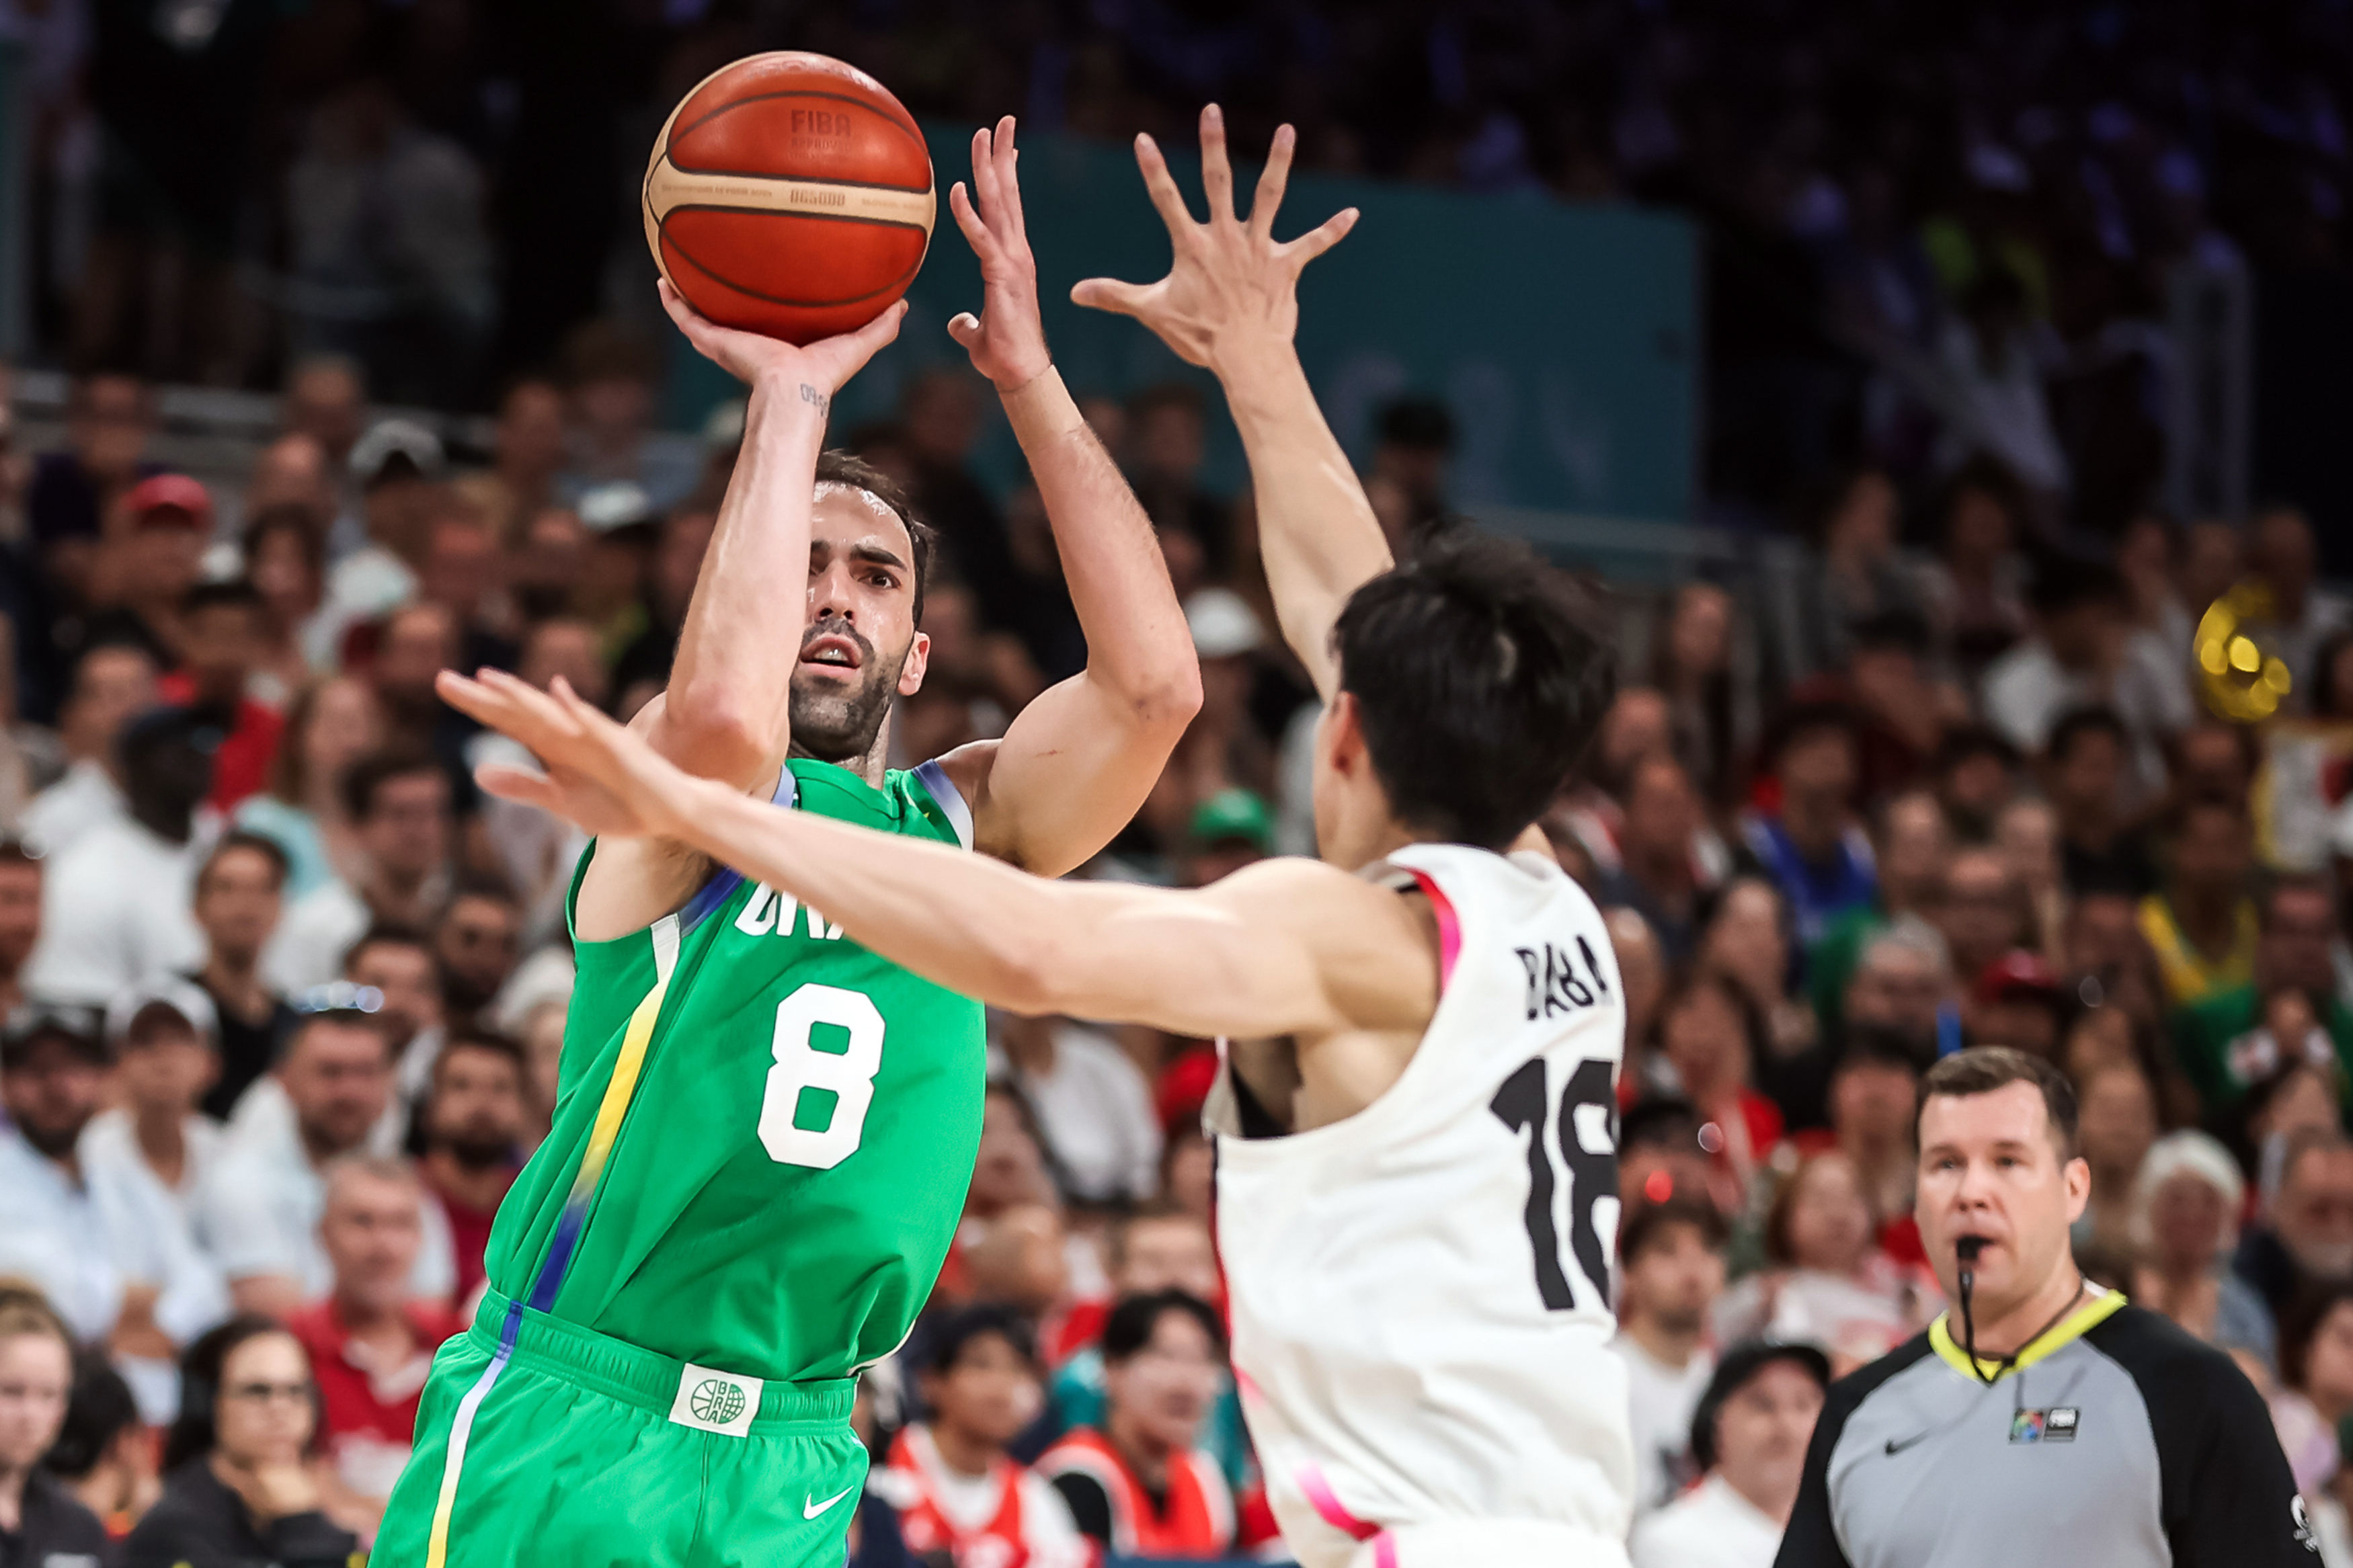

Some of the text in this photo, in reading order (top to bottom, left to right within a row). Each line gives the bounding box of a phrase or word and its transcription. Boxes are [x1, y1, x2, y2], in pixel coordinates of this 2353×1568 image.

[791, 109, 850, 137] FIBA
[756, 983, 886, 1171] 8
[1489, 1056, 1620, 1314] 18
[707, 1380, 728, 1423] BRA
